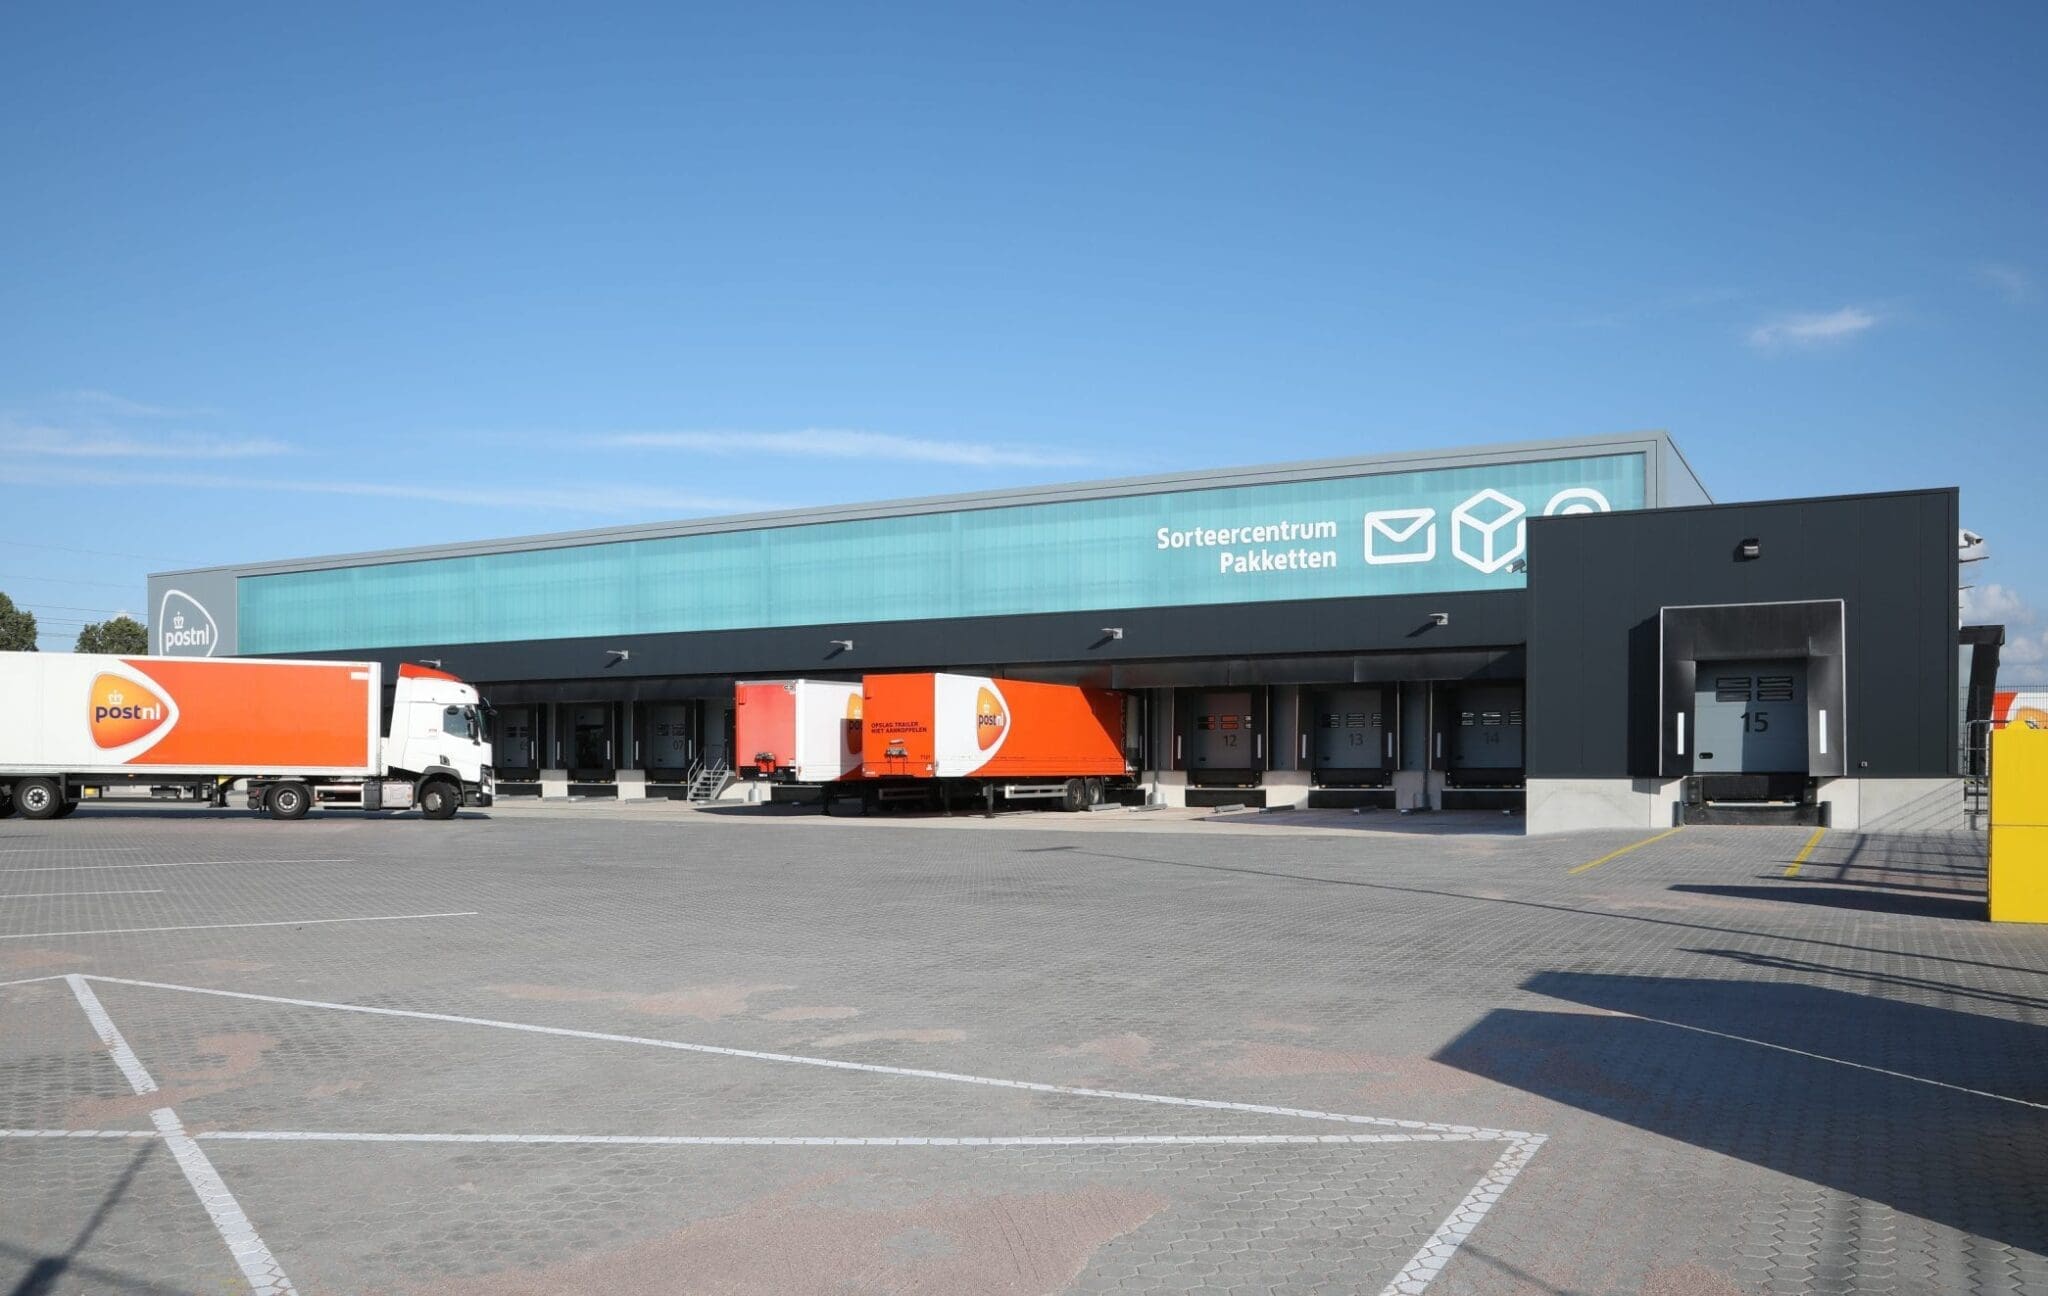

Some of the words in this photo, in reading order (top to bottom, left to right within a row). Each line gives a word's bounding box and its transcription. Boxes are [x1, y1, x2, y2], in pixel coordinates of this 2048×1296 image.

[1157, 520, 1337, 549] Sorteercentrum
[1220, 549, 1337, 574] Pakketten
[165, 623, 210, 653] postnl
[95, 703, 161, 723] postnl
[1740, 711, 1769, 733] 15
[672, 739, 684, 751] 07
[1223, 734, 1238, 747] 12
[1348, 732, 1364, 746] 13
[1482, 731, 1499, 745] 14
